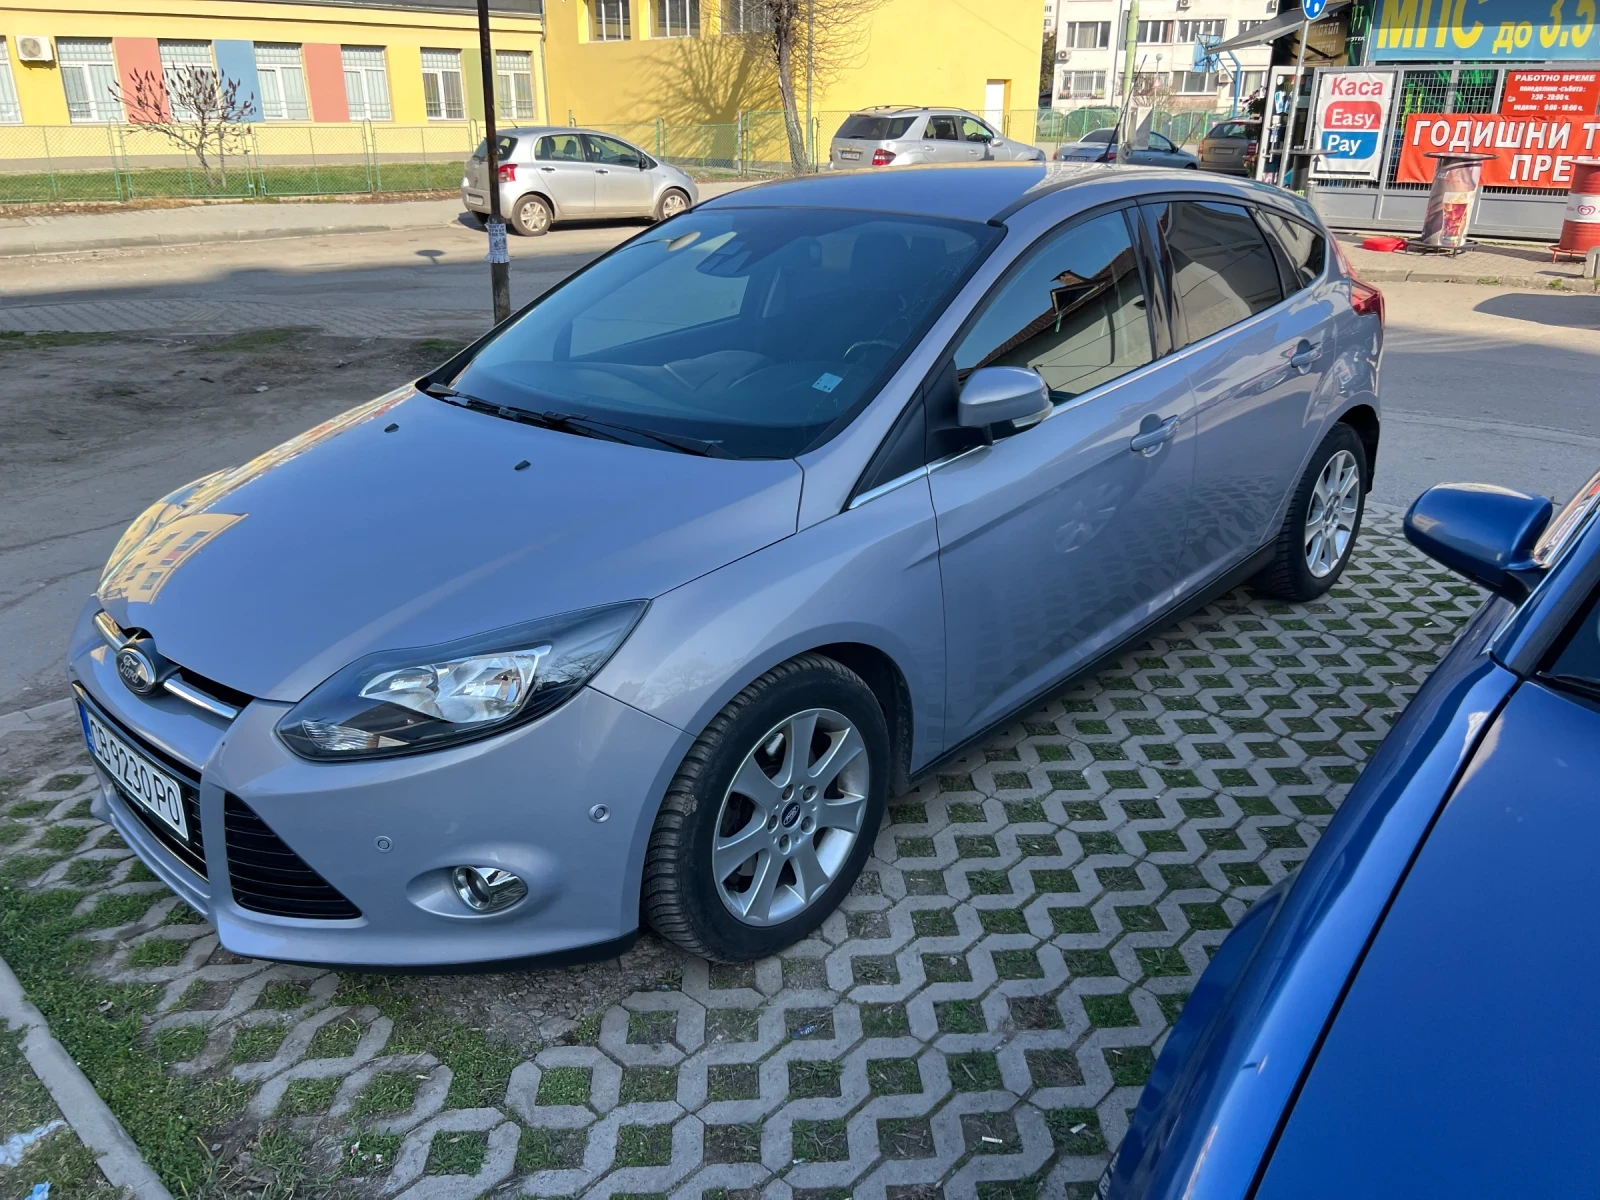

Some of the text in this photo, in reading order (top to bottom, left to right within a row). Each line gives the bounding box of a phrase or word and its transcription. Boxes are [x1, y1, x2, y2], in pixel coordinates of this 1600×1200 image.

[1377, 0, 1489, 48] МПС
[1492, 21, 1533, 54] до
[1331, 77, 1384, 96] Каса
[1515, 74, 1596, 82] РАБОТНО ВРЕМЕ
[1331, 109, 1376, 129] Easy
[1327, 134, 1362, 155] Pay
[1412, 120, 1572, 152] ГОДИШНИ
[1509, 154, 1595, 181] ПРЕ
[119, 654, 140, 685] Ford
